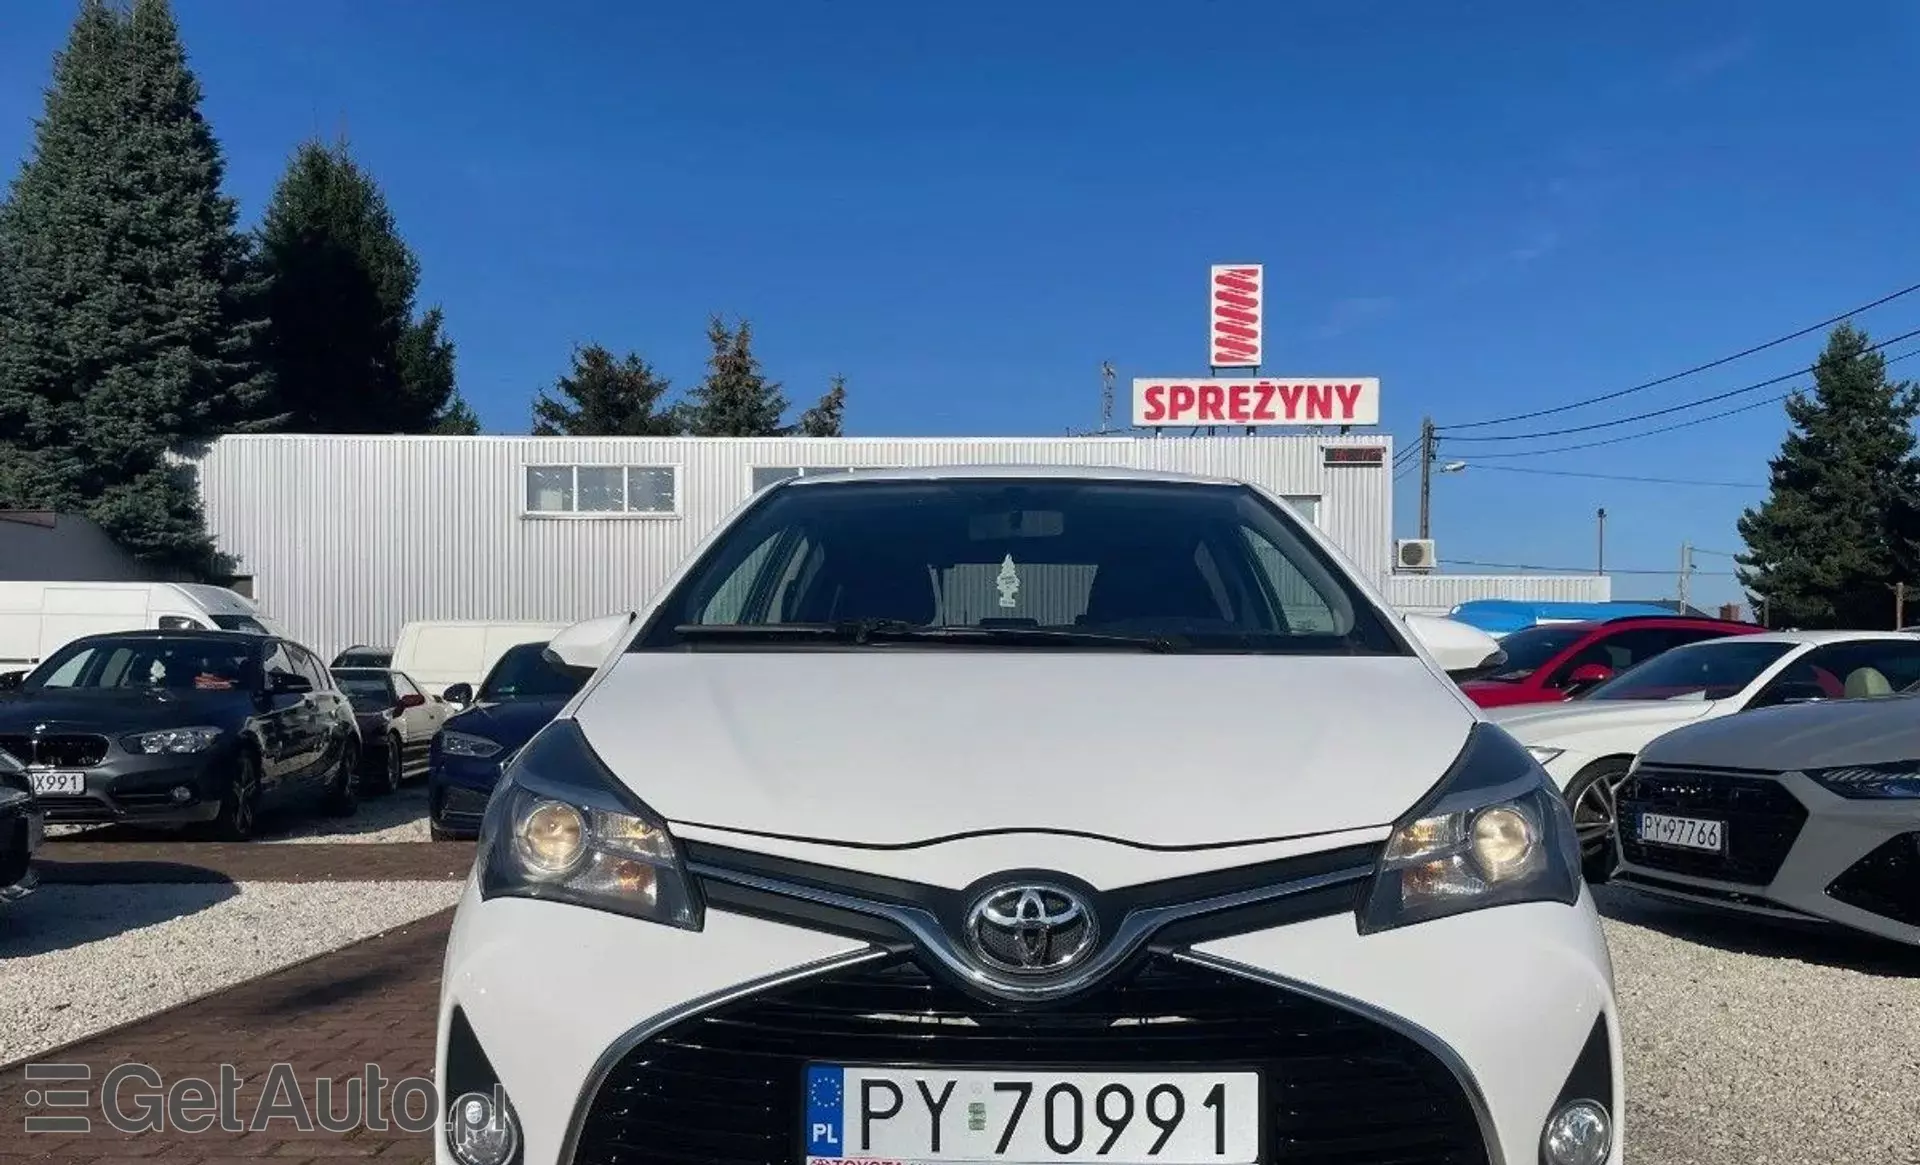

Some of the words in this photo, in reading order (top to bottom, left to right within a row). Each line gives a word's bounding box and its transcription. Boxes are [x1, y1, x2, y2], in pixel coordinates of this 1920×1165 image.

[1143, 381, 1363, 423] SPRĘŻYNY
[1644, 815, 1662, 838] PY
[1667, 819, 1718, 846] 97766
[812, 1123, 838, 1144] PL
[860, 1078, 958, 1153] PY
[993, 1081, 1226, 1155] 70991
